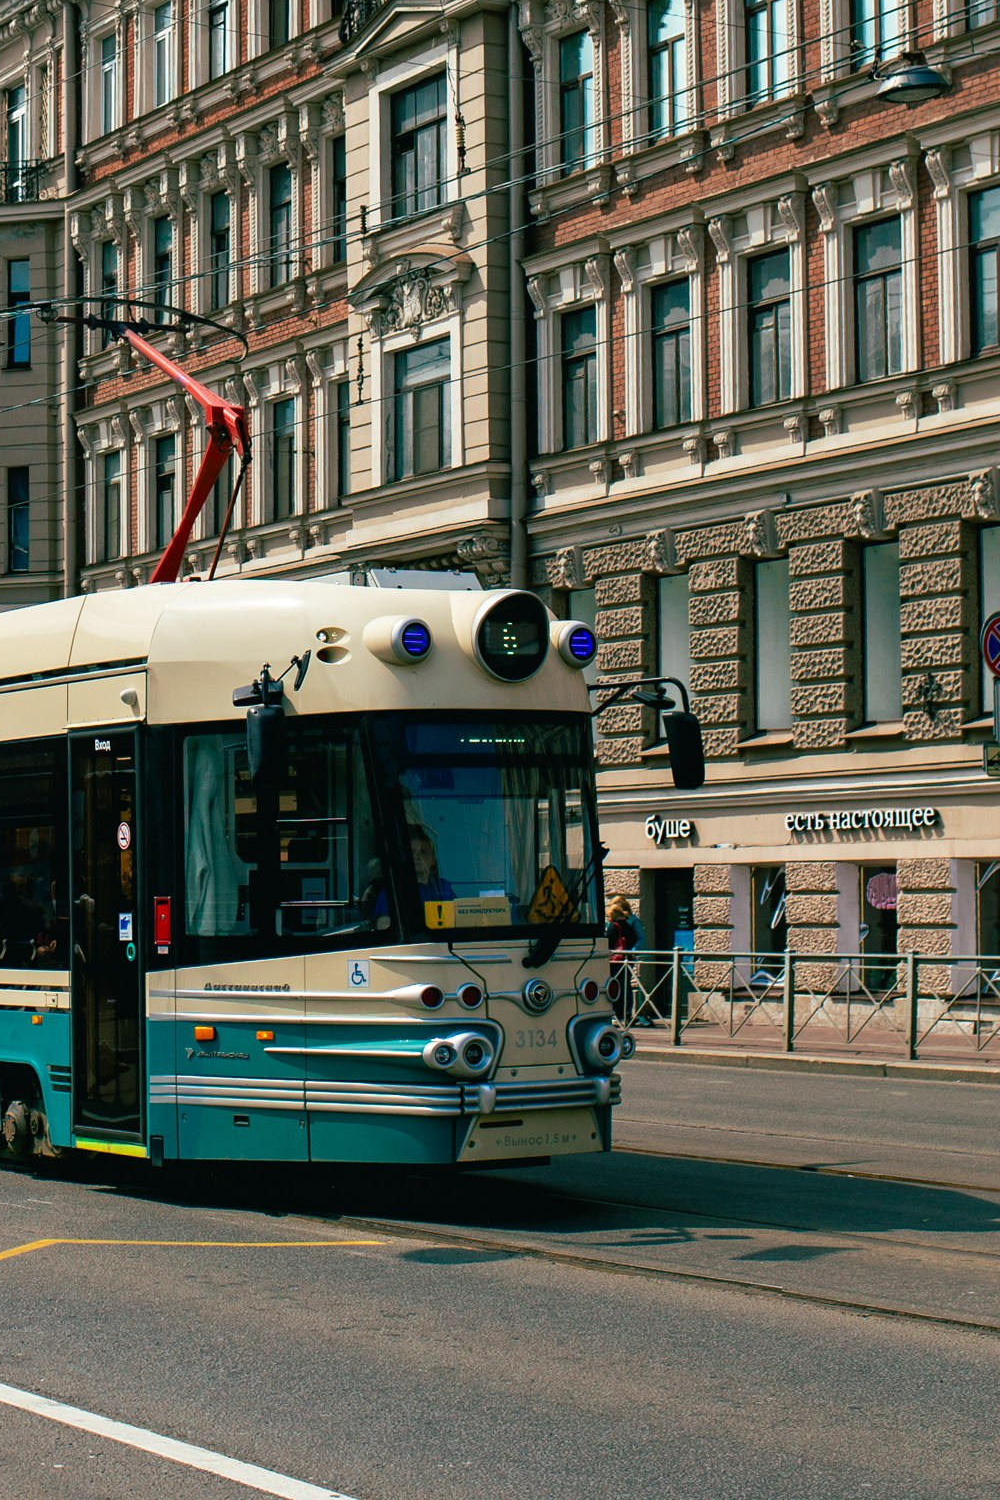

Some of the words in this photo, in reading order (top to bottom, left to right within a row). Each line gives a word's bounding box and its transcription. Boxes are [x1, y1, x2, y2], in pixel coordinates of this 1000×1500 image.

[95, 739, 111, 751] Вход
[645, 815, 691, 844] буше
[785, 812, 824, 832] есть
[830, 807, 936, 831] настоящее
[515, 1029, 558, 1049] 3134
[504, 1136, 543, 1147] Вынос
[545, 1133, 560, 1145] 1,5
